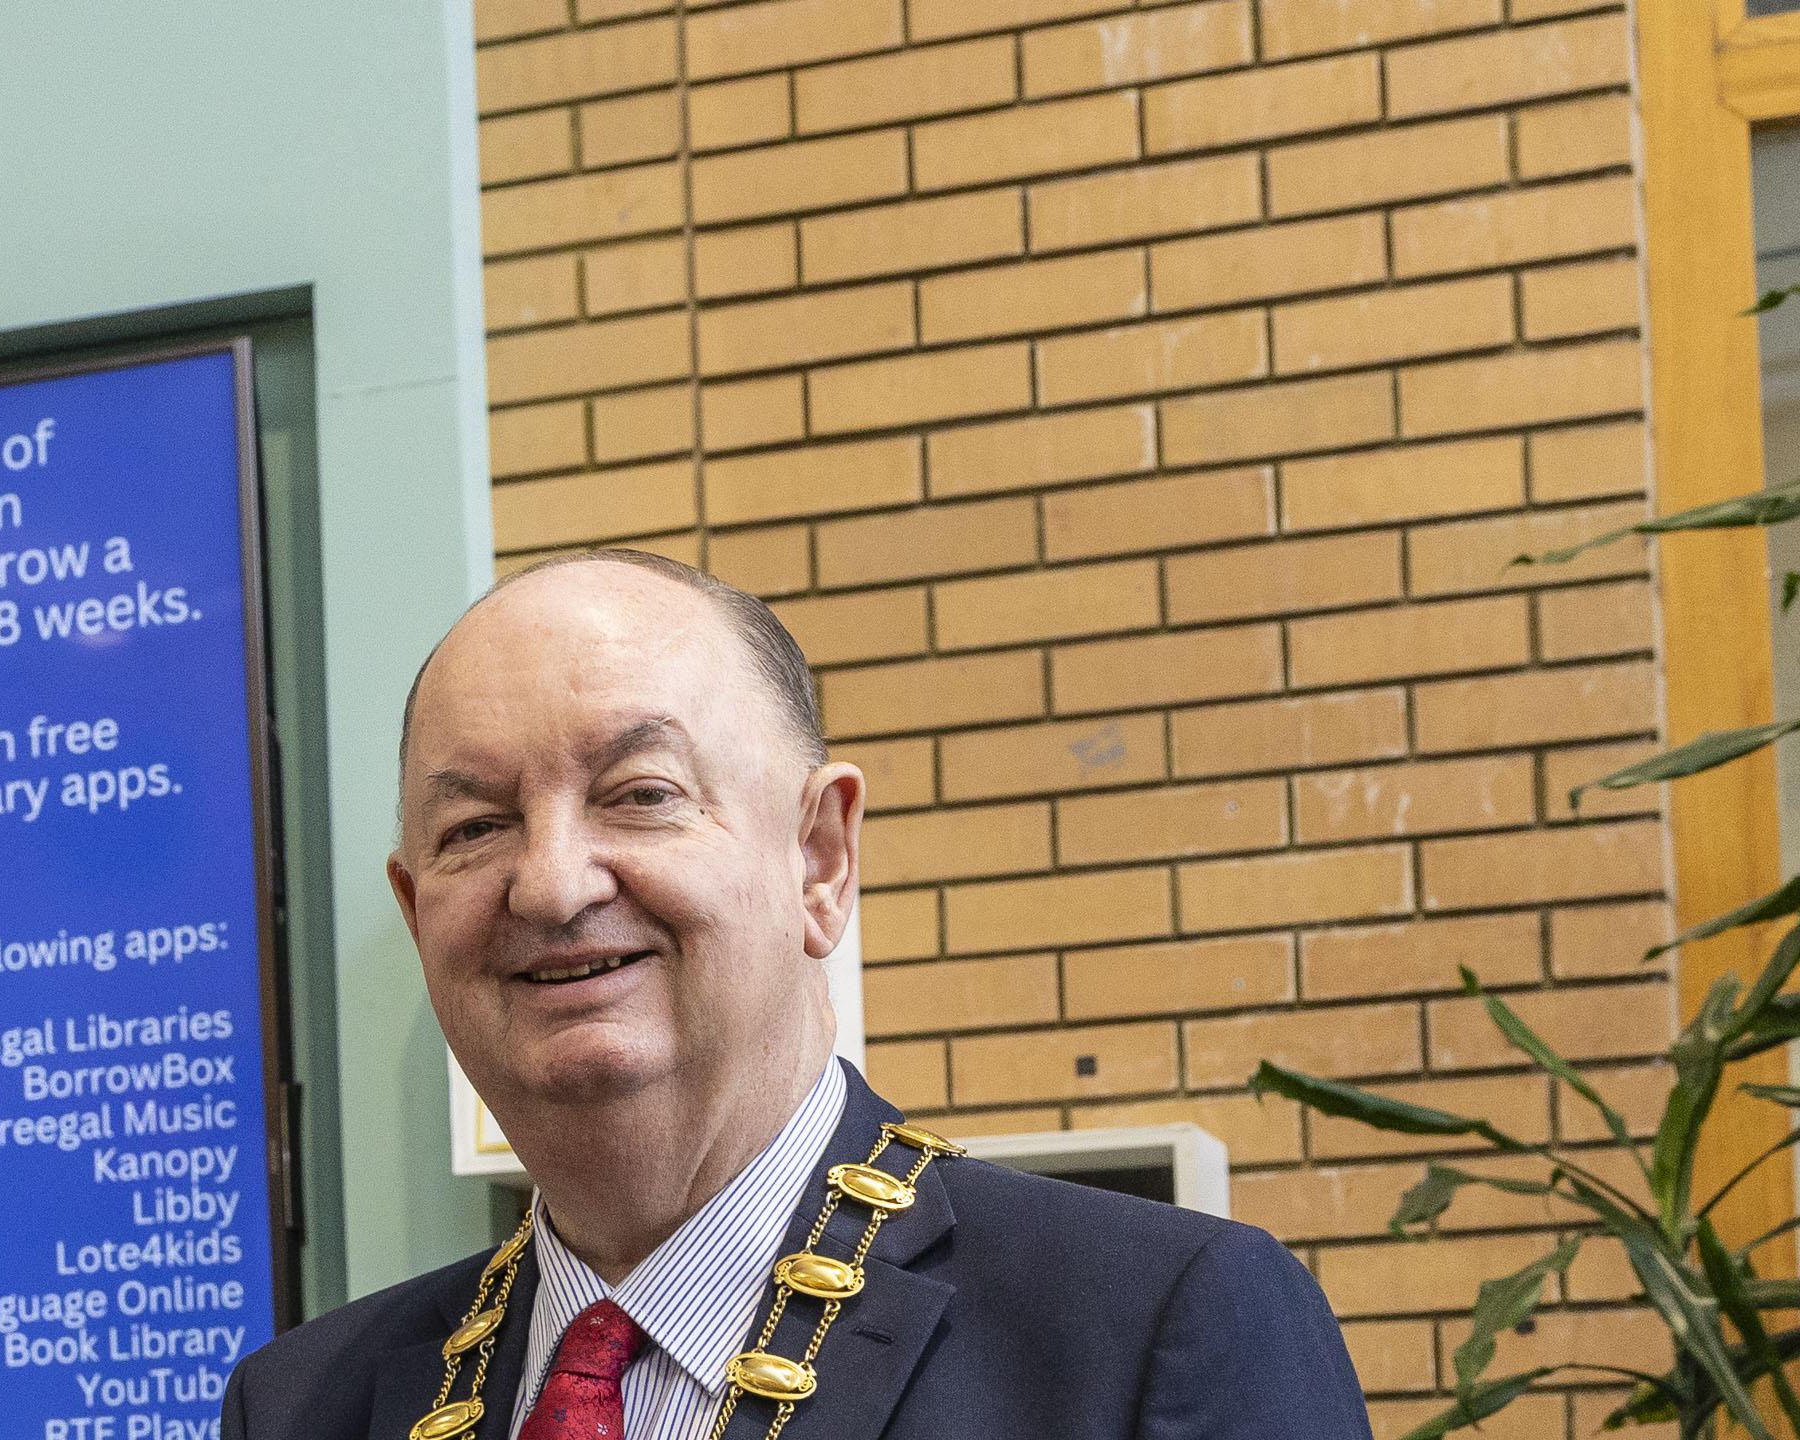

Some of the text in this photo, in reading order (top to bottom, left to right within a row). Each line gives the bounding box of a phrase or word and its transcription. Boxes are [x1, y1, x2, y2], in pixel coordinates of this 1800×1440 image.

[3, 420, 57, 470] of
[103, 537, 133, 574] a
[33, 585, 203, 640] weeks.
[30, 715, 119, 757] free
[61, 759, 183, 808] apps.
[125, 921, 229, 964] apps:
[66, 1008, 233, 1054] Libraries
[23, 1054, 236, 1102] BorrowBox
[123, 1099, 237, 1138] Music
[94, 1146, 238, 1184] Kanopy
[133, 1189, 240, 1227] Libby
[56, 1235, 242, 1277] Lote4kids
[118, 1277, 244, 1316] Online
[5, 1324, 99, 1366] Book
[108, 1322, 245, 1363] Library
[76, 1364, 230, 1407] YouTub
